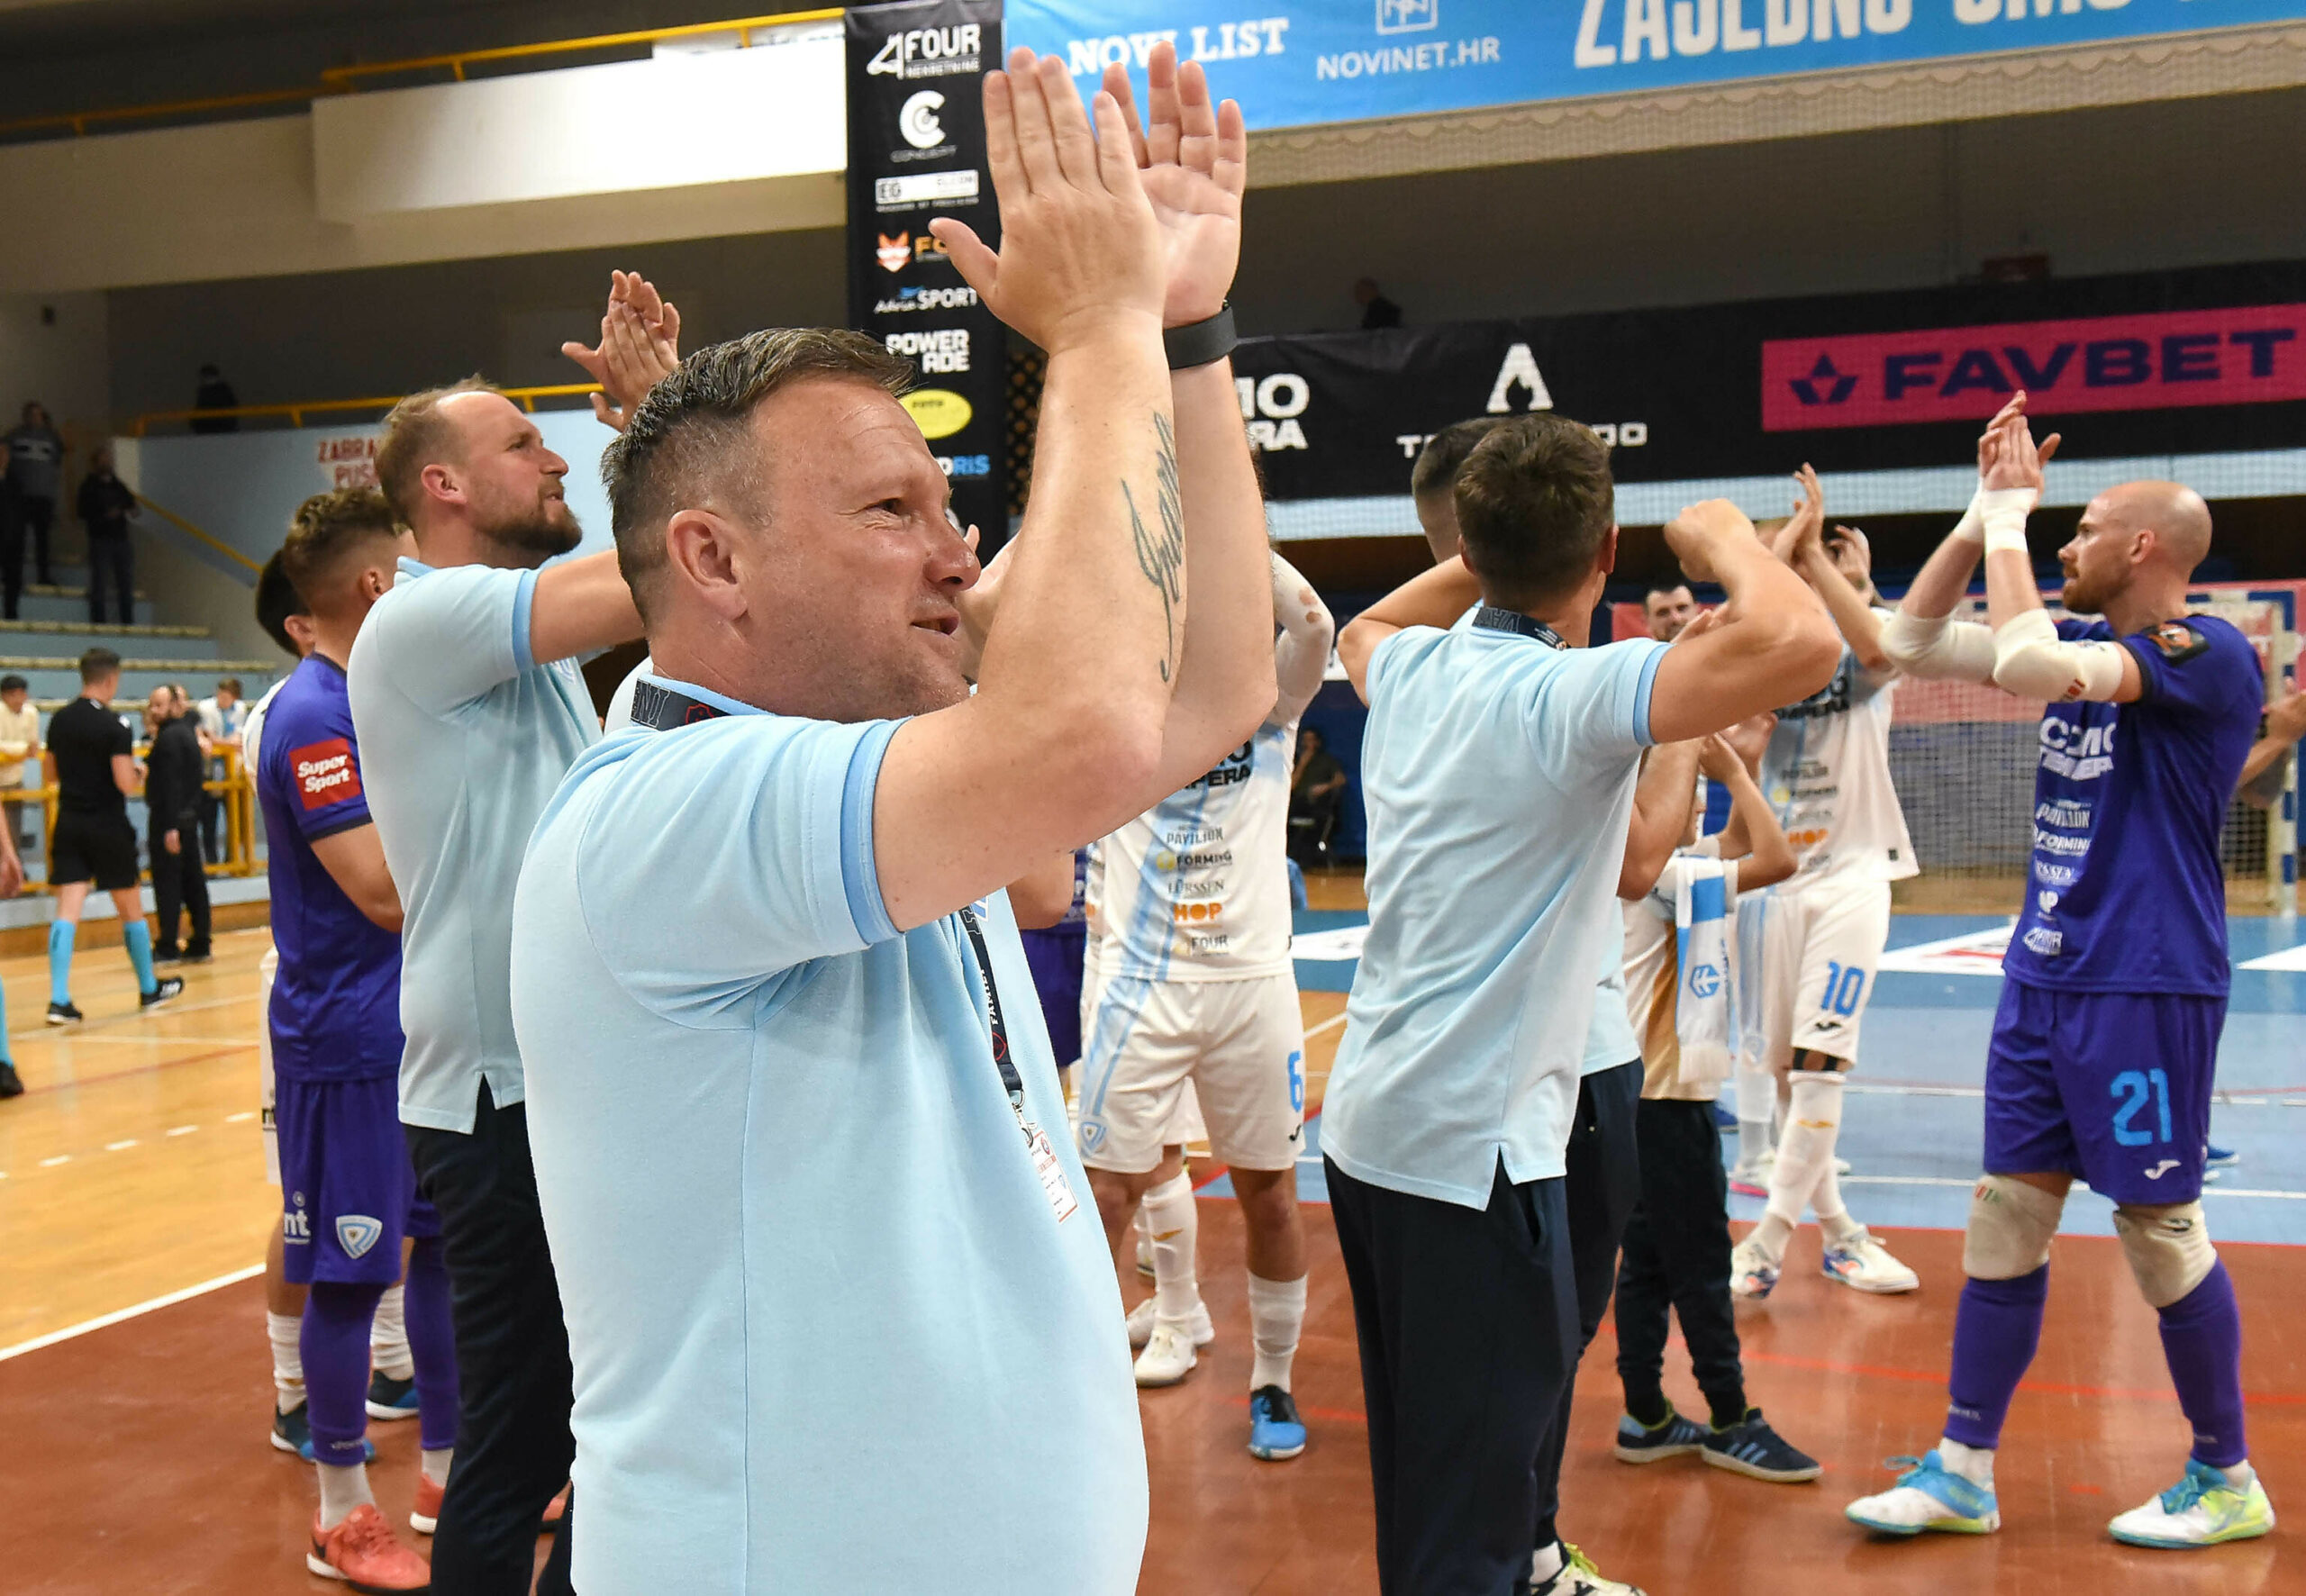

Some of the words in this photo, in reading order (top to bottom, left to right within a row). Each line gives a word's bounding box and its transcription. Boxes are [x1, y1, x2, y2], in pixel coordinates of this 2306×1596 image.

[904, 23, 981, 62] FOUR
[1190, 17, 1290, 63] LIST
[1316, 37, 1501, 81] NOVINET.HR
[917, 286, 978, 311] SPORT
[885, 329, 970, 356] POWER
[1883, 329, 2296, 400] FAVBET
[297, 754, 348, 779] Super
[304, 767, 350, 793] Sport
[1820, 961, 1866, 1017] 10
[1288, 1050, 1303, 1112] 6
[2110, 1067, 2173, 1147] 21
